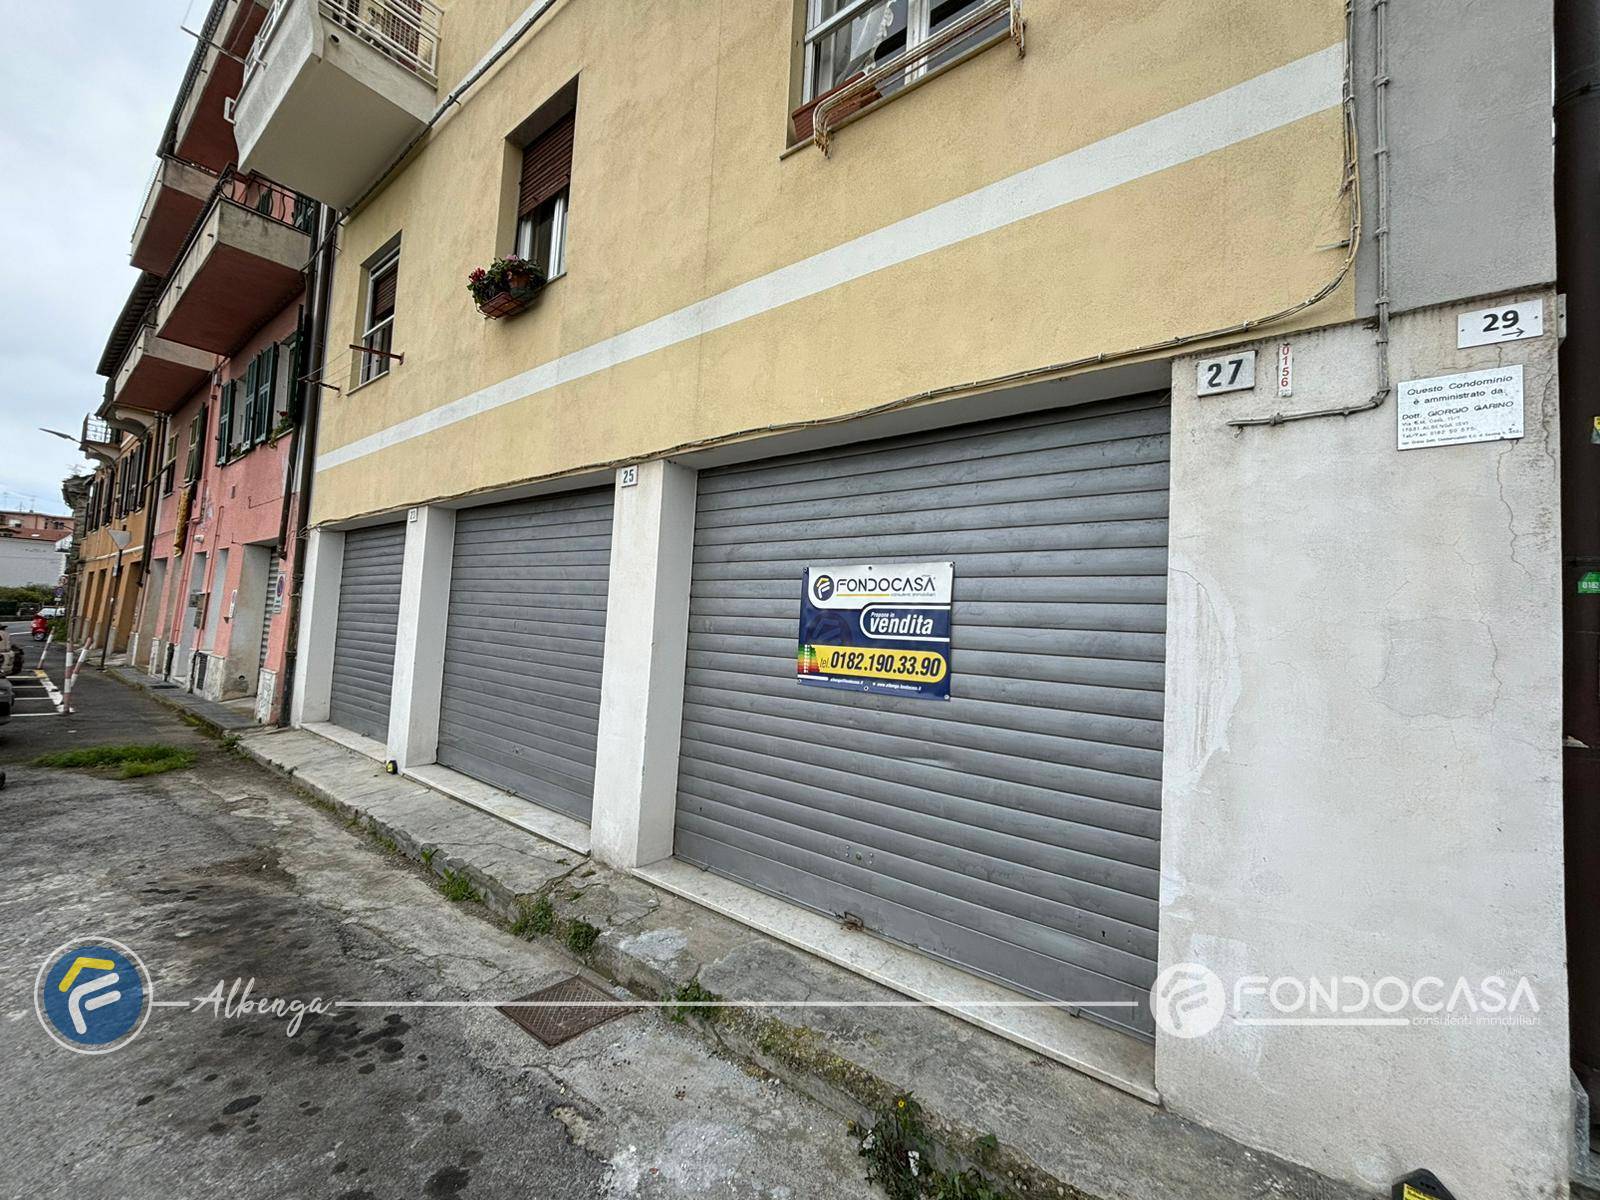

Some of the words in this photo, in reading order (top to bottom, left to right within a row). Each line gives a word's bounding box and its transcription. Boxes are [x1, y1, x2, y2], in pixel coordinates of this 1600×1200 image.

[1482, 309, 1519, 332] 29
[1207, 358, 1243, 388] 27
[1280, 346, 1290, 387] 0156
[1407, 385, 1443, 396] Questo
[1448, 375, 1513, 390] Condominio
[1424, 390, 1486, 404] amministrato
[1428, 406, 1469, 417] GIORGIO
[1474, 400, 1514, 411] GARINO
[623, 469, 634, 483] 25
[836, 577, 935, 592] FONDOCASA
[870, 614, 934, 635] vendita
[830, 651, 942, 677] 0182.190.33.90
